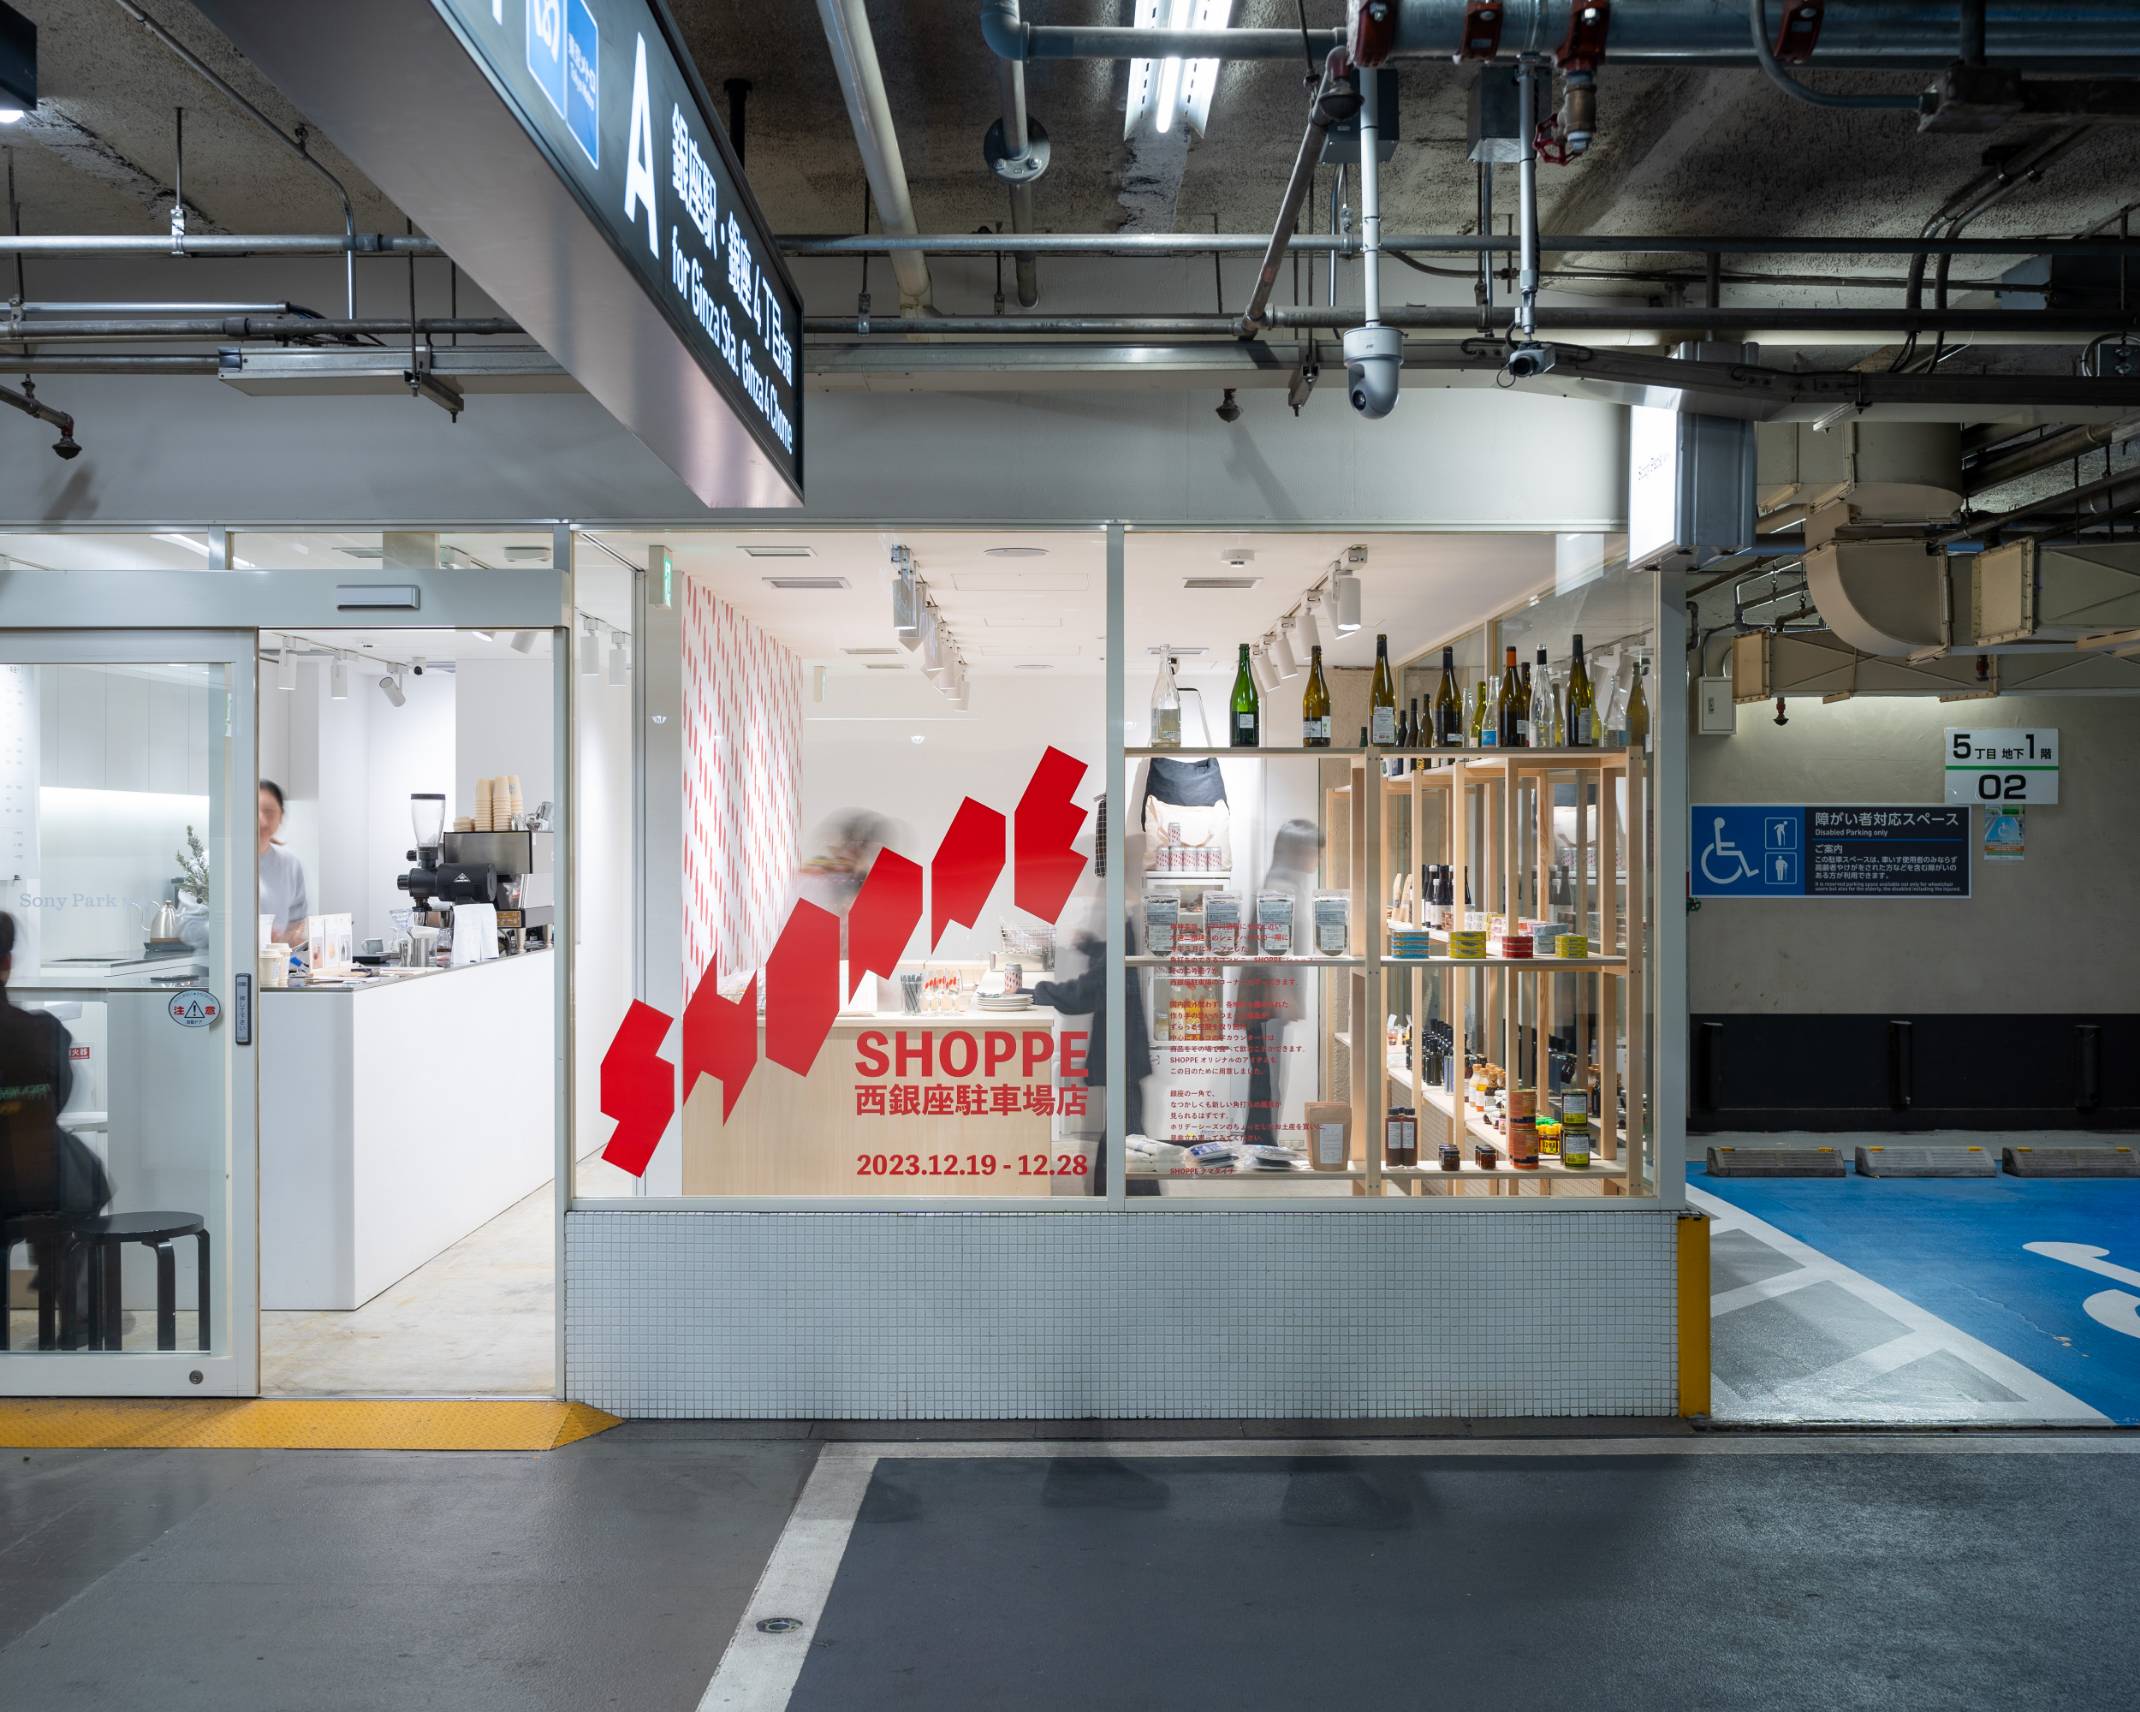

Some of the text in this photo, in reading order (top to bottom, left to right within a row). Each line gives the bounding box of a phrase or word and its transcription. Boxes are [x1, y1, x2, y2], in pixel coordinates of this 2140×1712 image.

[624, 32, 660, 260] A
[671, 225, 793, 455] for Ginza Sta. Ginza 4 Chome
[1952, 733, 2053, 760] 5丁目 地下1階
[1978, 773, 2027, 800] 02
[1815, 812, 1960, 827] 障がい者対応スペース
[1846, 829, 1872, 837] Parking
[1873, 829, 1889, 837] only
[1815, 844, 1843, 854] ご案内
[19, 893, 67, 911] Sony
[72, 893, 118, 908] Park
[174, 1006, 216, 1016] 注 意
[855, 1030, 1089, 1078] SHOPPE
[855, 1083, 1089, 1117] 西銀座駐車場店
[857, 1154, 996, 1176] 2023.12.19
[1018, 1154, 1088, 1176] 12.28
